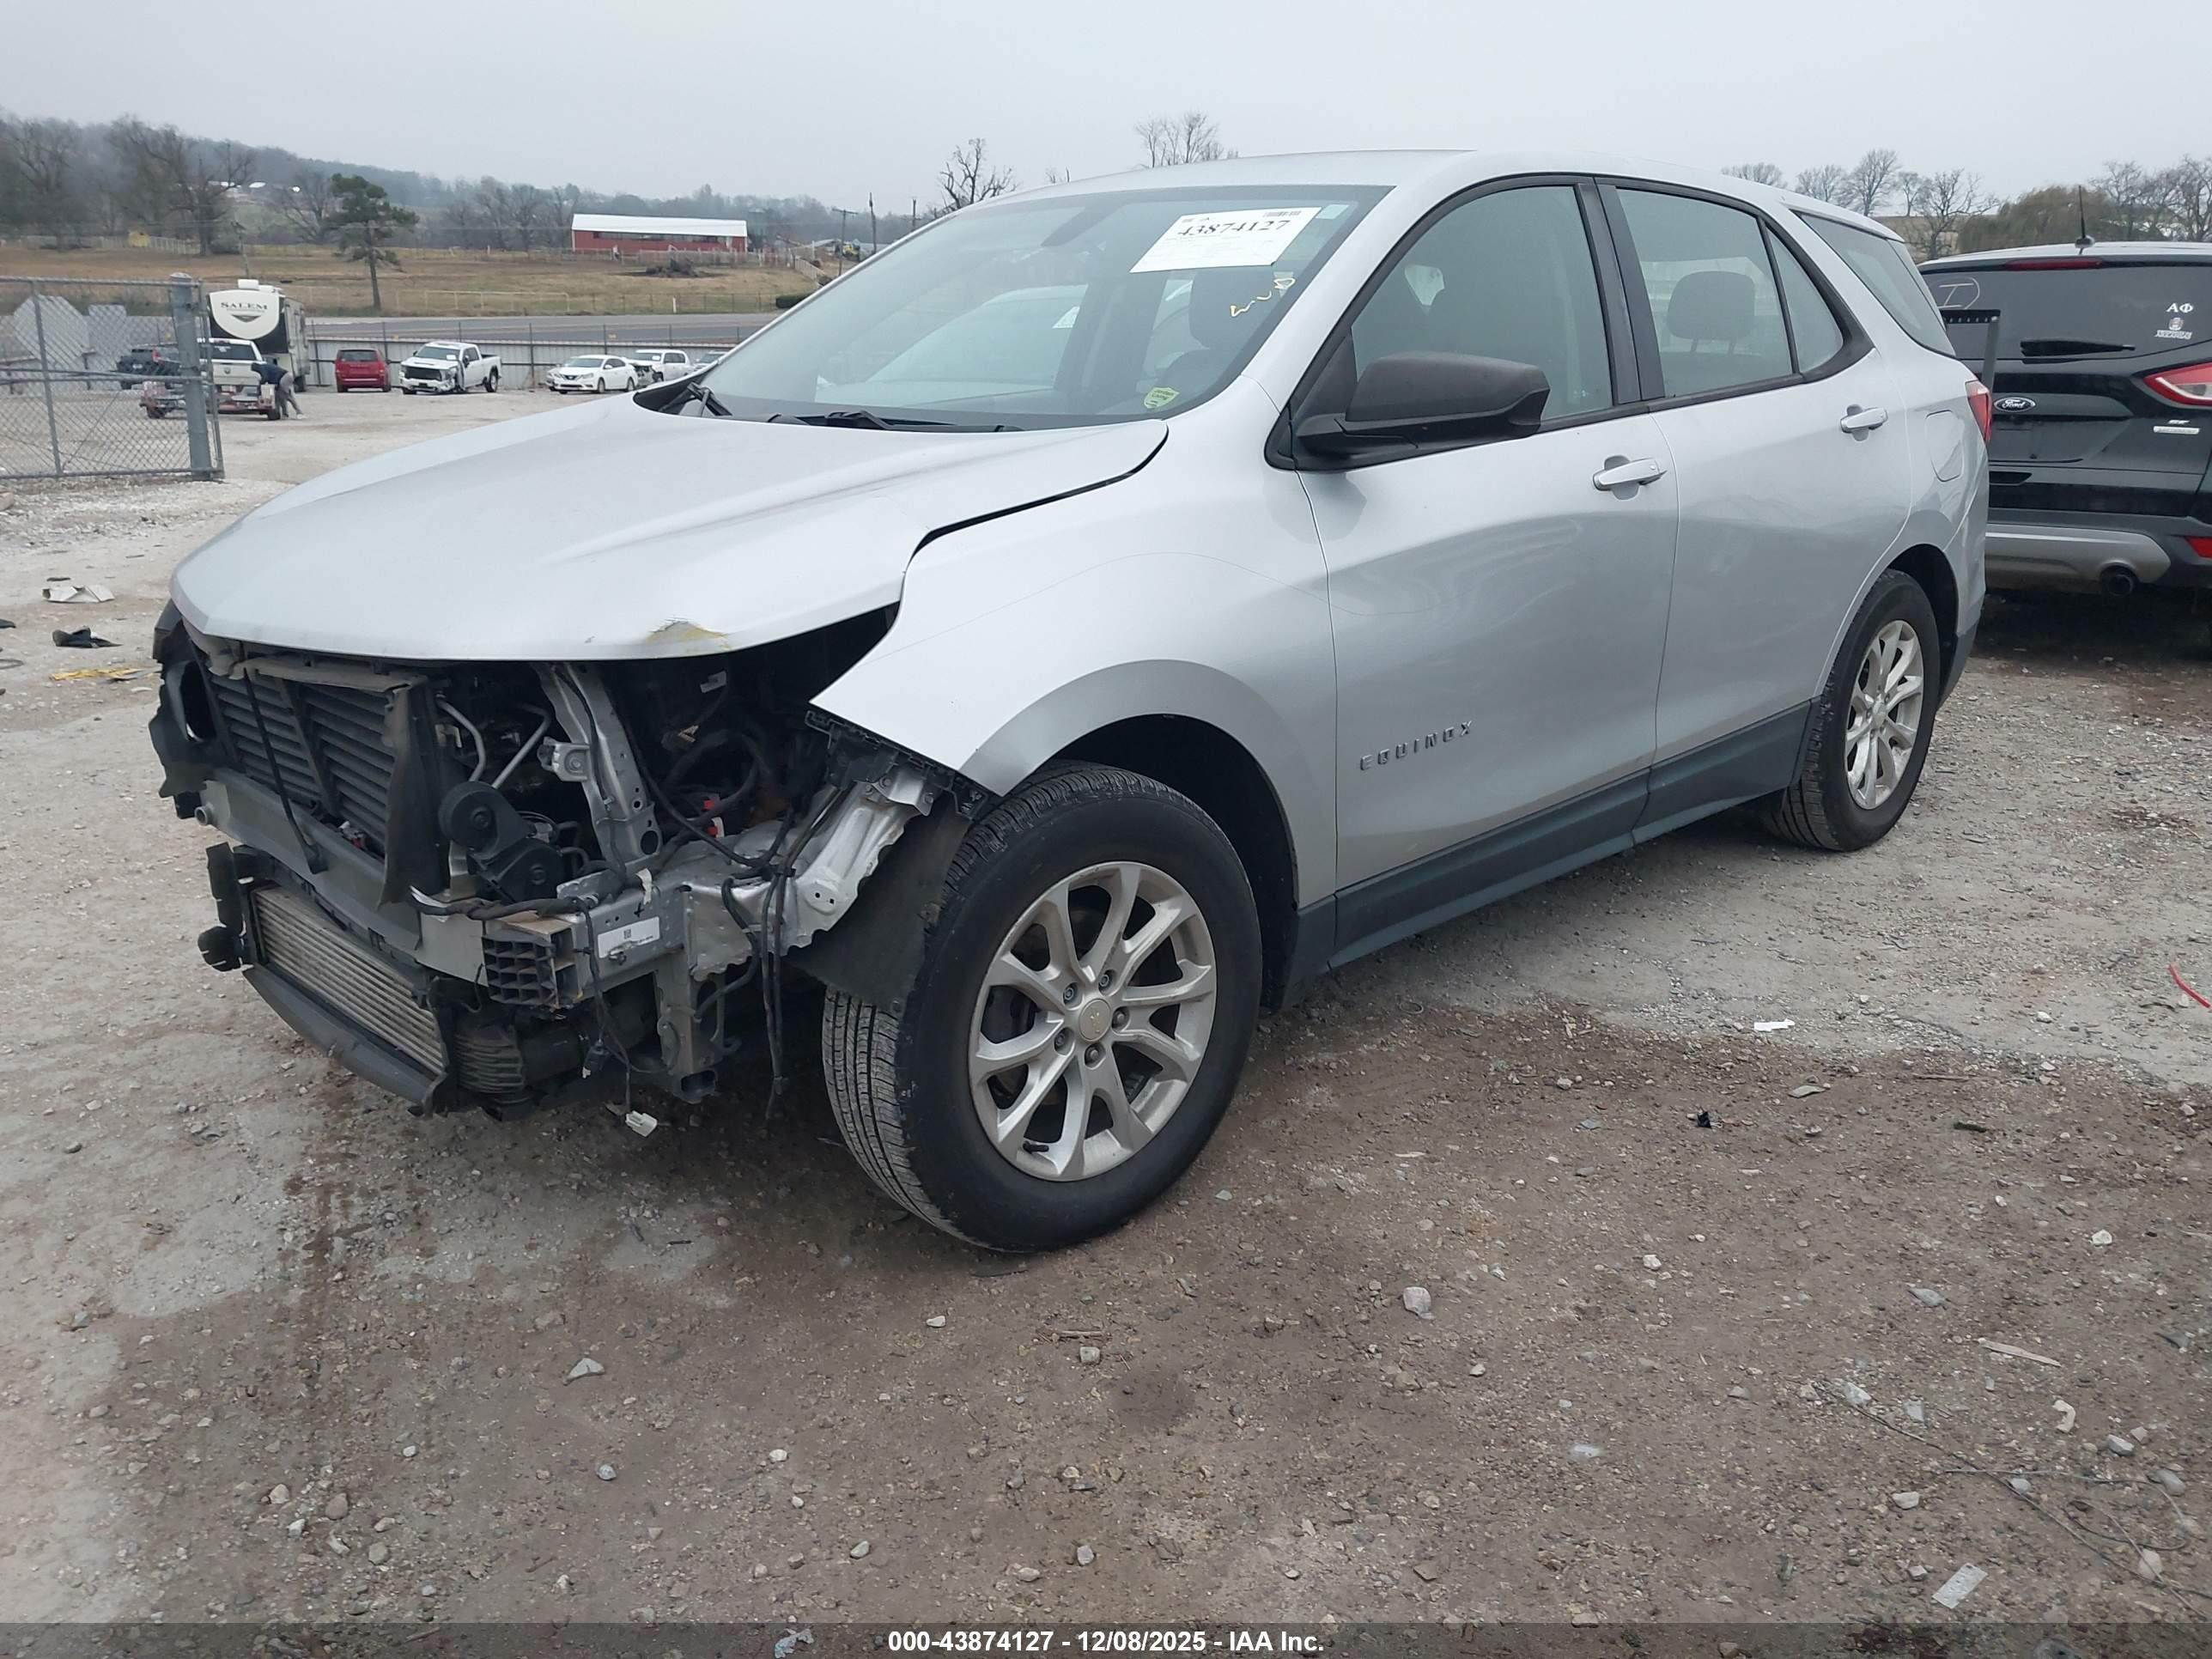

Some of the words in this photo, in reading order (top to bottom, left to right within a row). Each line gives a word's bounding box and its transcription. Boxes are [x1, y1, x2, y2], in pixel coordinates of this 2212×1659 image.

[1177, 220, 1292, 236] 43874127
[220, 301, 268, 310] SALEM
[2002, 398, 2027, 409] Ford
[1359, 720, 1473, 771] EQUINOX
